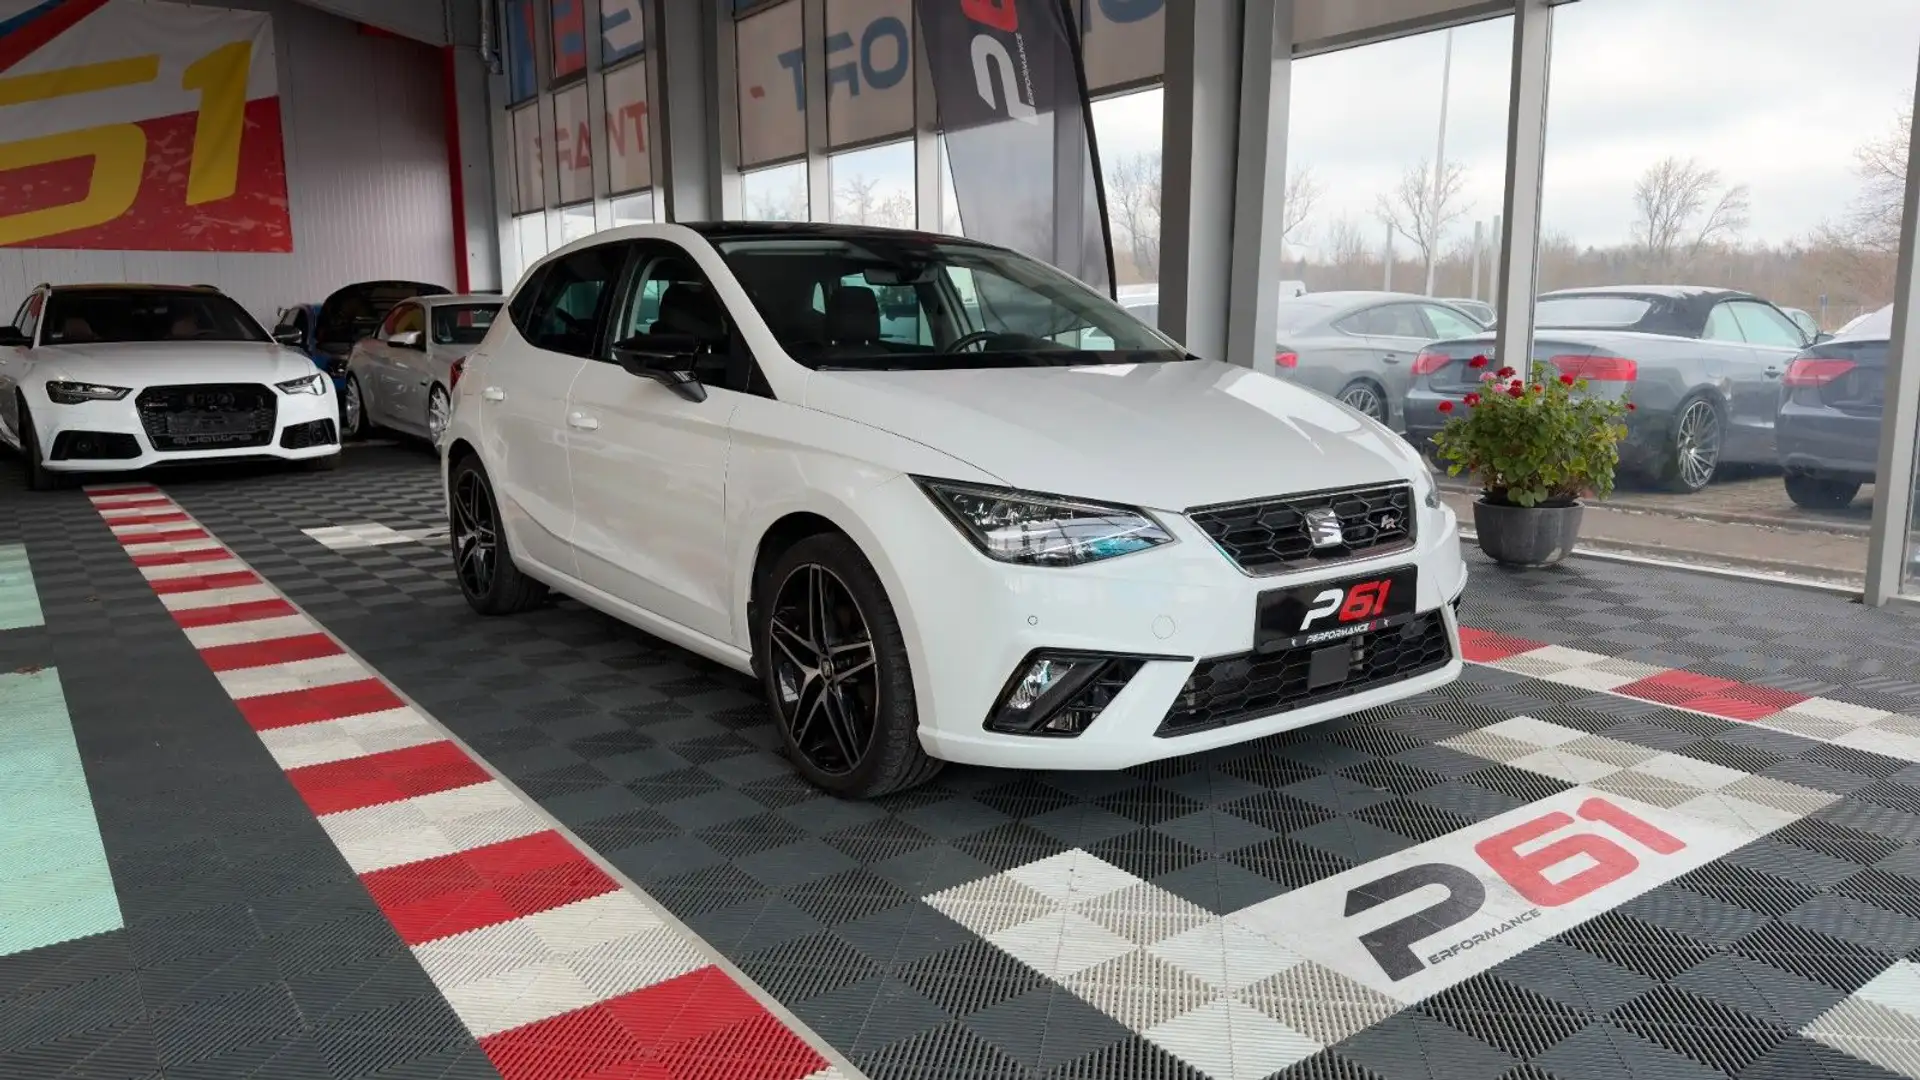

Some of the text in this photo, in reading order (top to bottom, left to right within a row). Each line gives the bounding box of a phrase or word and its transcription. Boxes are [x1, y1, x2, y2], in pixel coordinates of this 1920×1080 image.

[1300, 579, 1391, 631] P61
[1306, 622, 1369, 644] PERFORMANCE
[1343, 796, 1688, 982] P61
